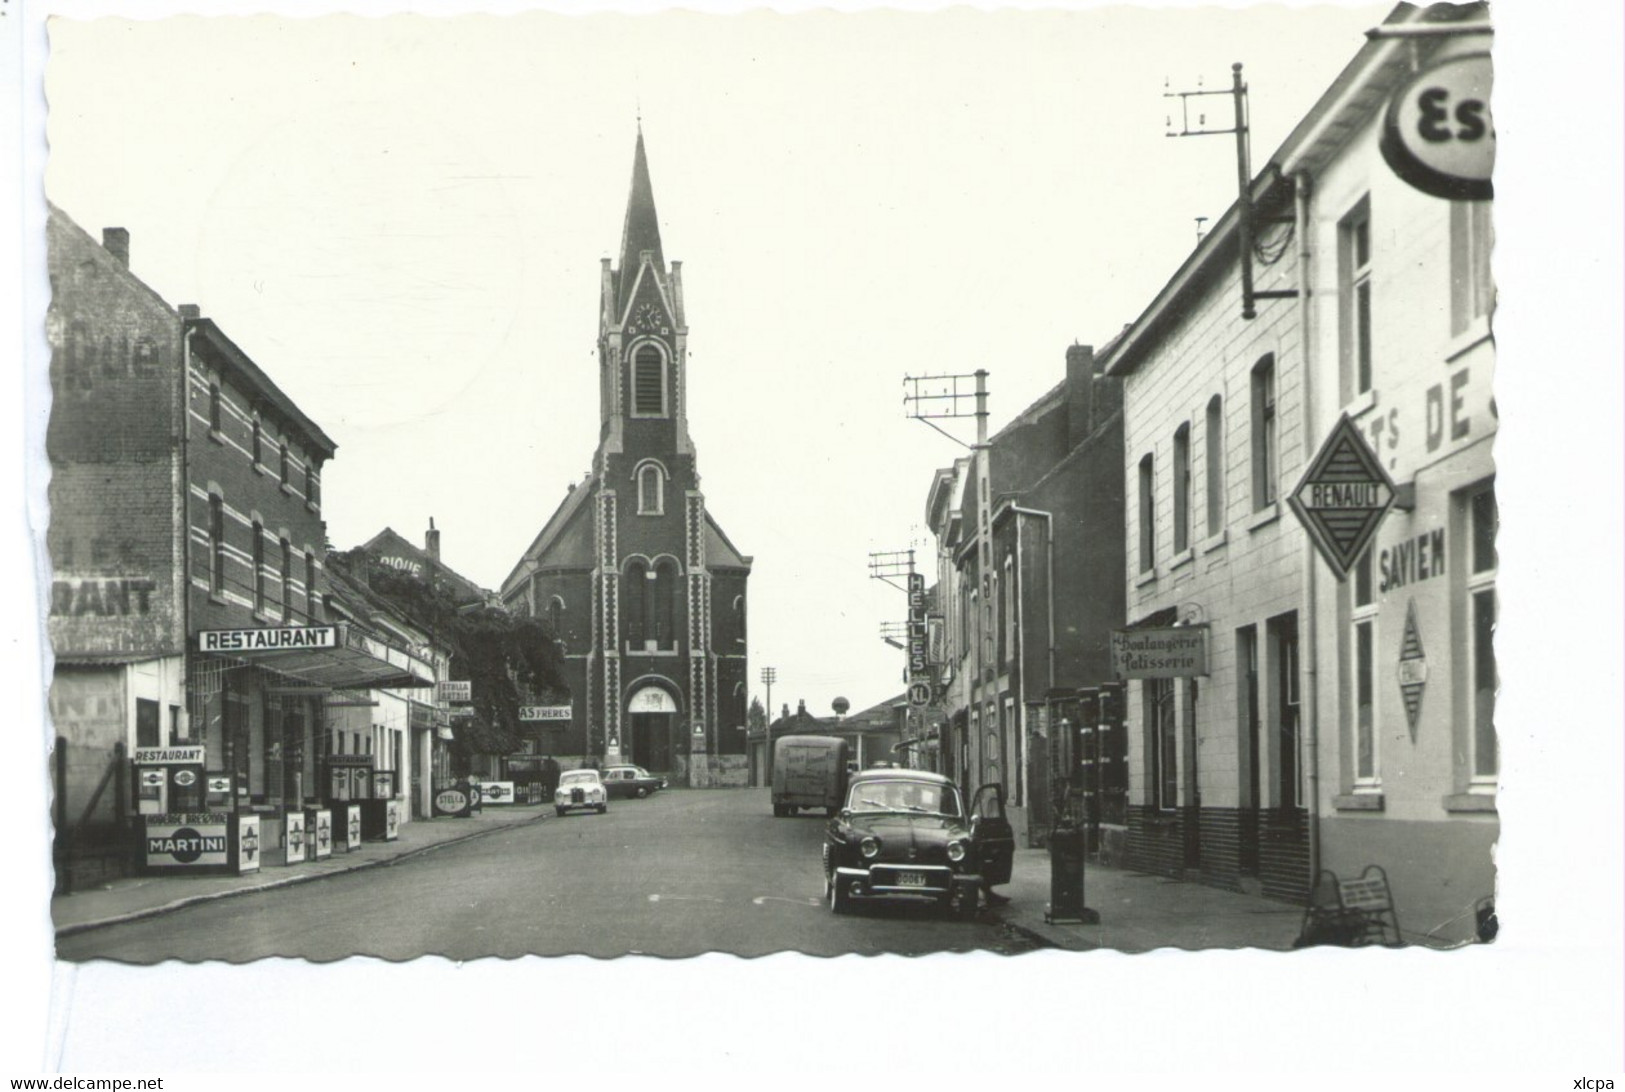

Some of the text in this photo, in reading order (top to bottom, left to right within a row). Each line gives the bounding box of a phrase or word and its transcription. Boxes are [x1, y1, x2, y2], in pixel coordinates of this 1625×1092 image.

[1417, 86, 1496, 144] Es
[1426, 367, 1471, 454] DE
[1312, 484, 1380, 508] RENAULT
[1379, 527, 1446, 594] SAVIEM
[910, 576, 925, 671] HELLES
[205, 628, 330, 650] RESTAURANT
[1114, 632, 1199, 653] Boulangerie
[135, 750, 202, 762] RESTAURANT
[439, 795, 465, 804] STELLA
[149, 838, 224, 853] MARTINI
